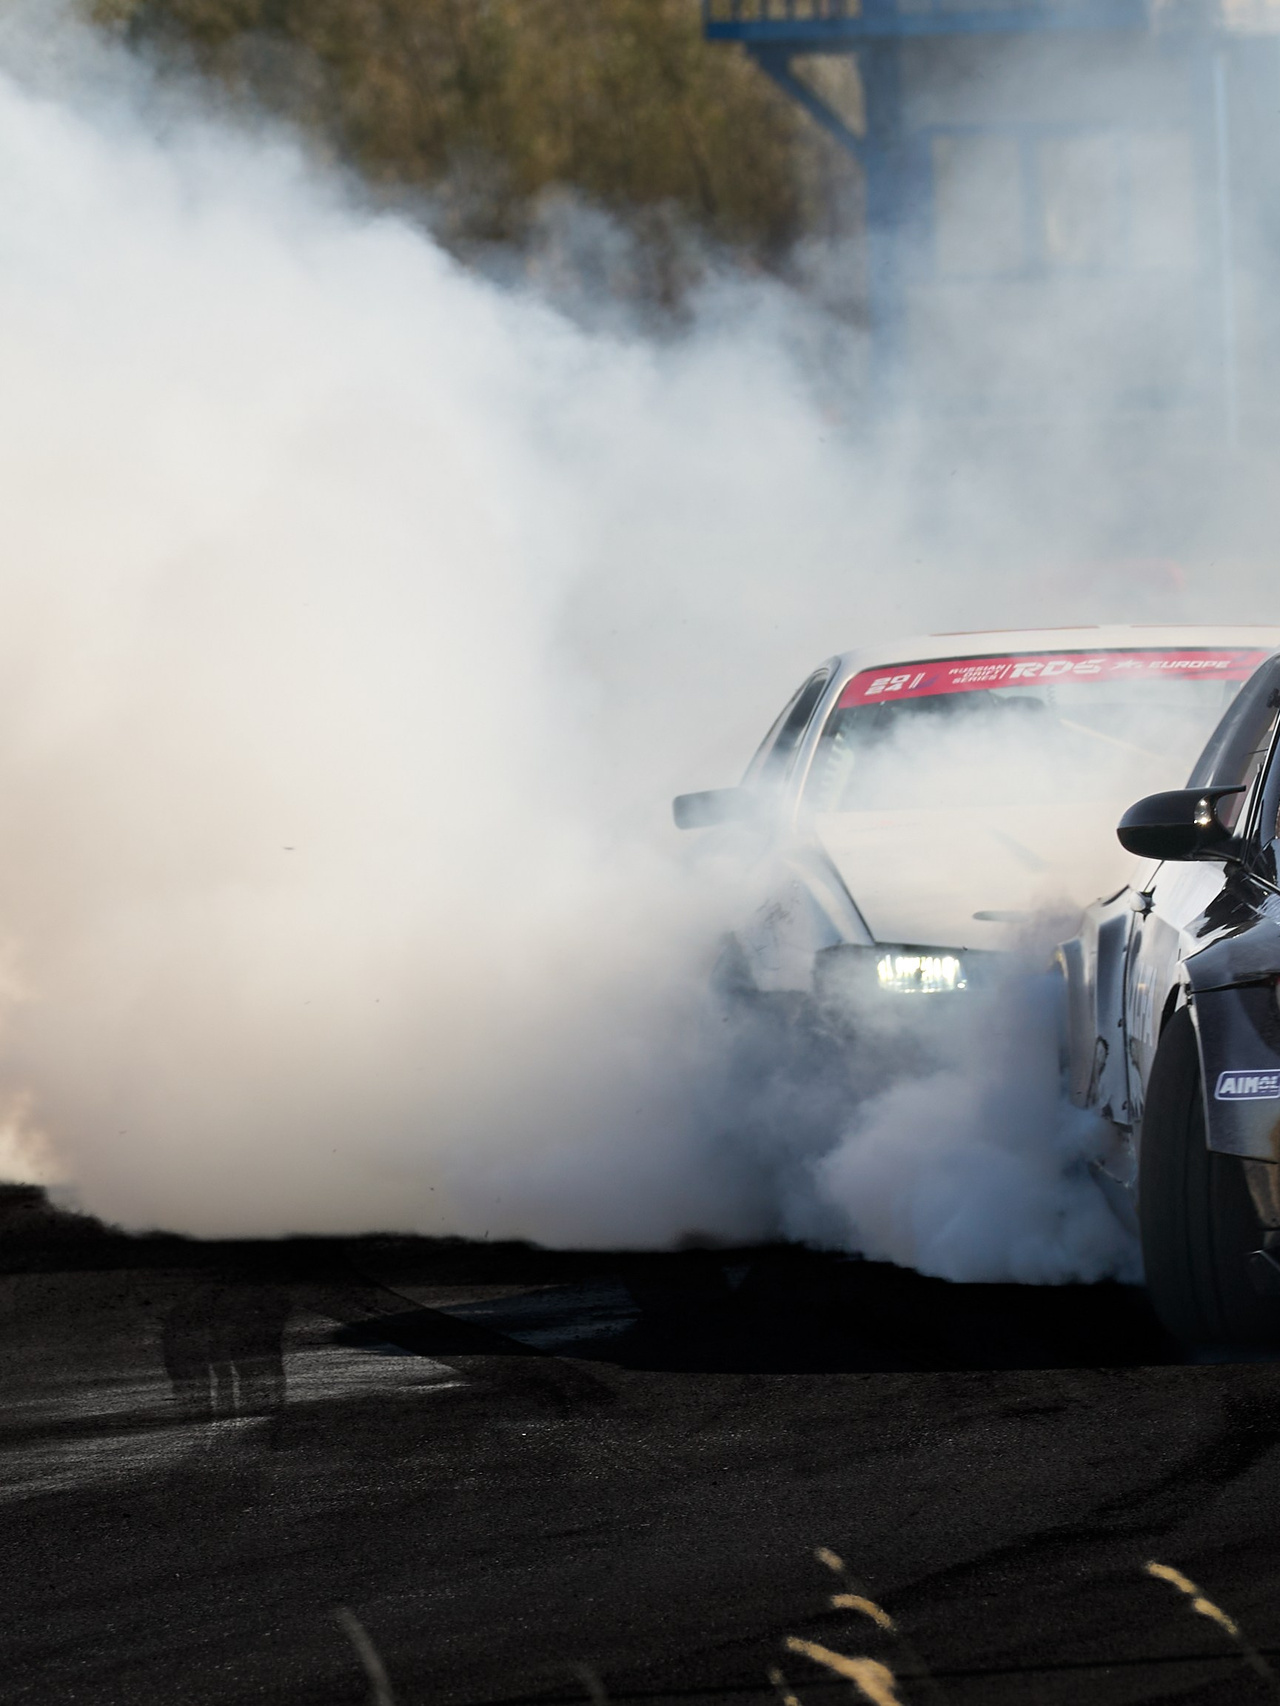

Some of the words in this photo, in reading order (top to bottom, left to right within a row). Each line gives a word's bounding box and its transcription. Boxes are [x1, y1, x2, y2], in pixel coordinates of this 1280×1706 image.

[948, 664, 1006, 675] RUSSIAN
[1009, 658, 1106, 679] RDS
[1149, 660, 1231, 669] EUROPE
